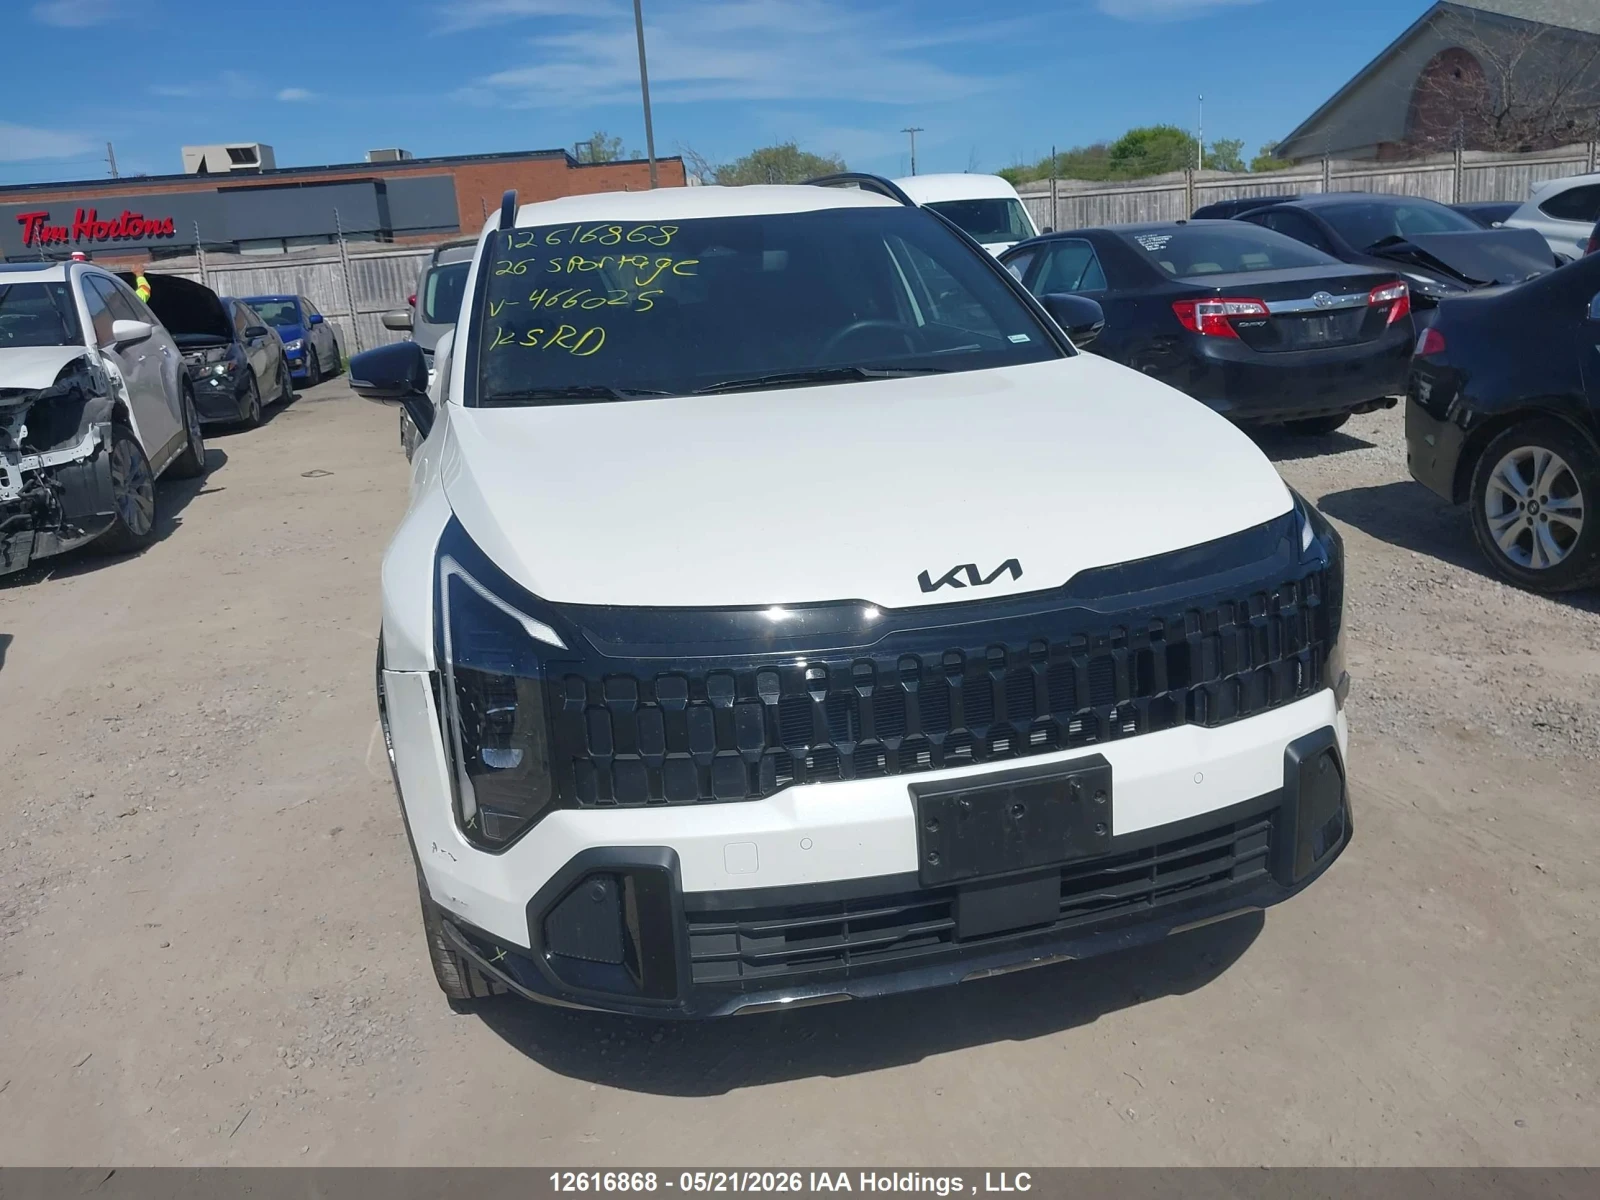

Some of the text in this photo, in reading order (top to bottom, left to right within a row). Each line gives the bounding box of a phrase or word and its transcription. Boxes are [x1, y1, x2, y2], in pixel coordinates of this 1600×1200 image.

[16, 207, 175, 246] Tim Hortons
[507, 224, 679, 250] 12616868
[495, 257, 535, 276] 26
[917, 558, 1024, 593] KIA
